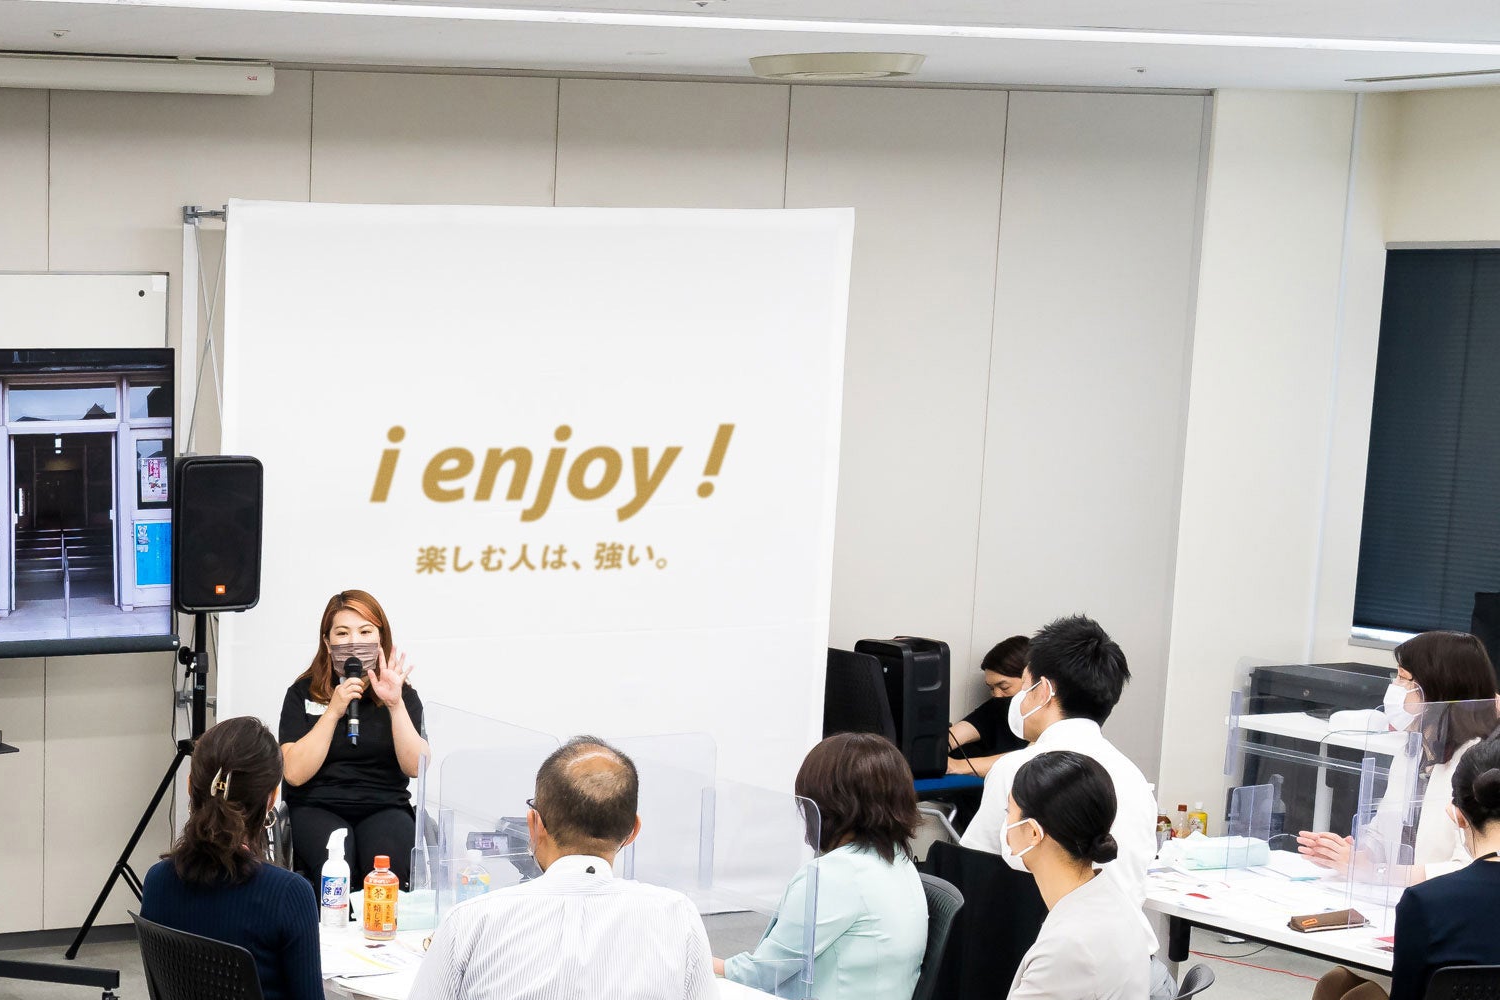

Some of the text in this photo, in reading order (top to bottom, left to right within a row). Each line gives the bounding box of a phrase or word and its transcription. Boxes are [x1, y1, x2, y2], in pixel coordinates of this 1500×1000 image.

[371, 424, 734, 522] i enjoy !
[416, 543, 667, 574] 楽しむ人は、強い。
